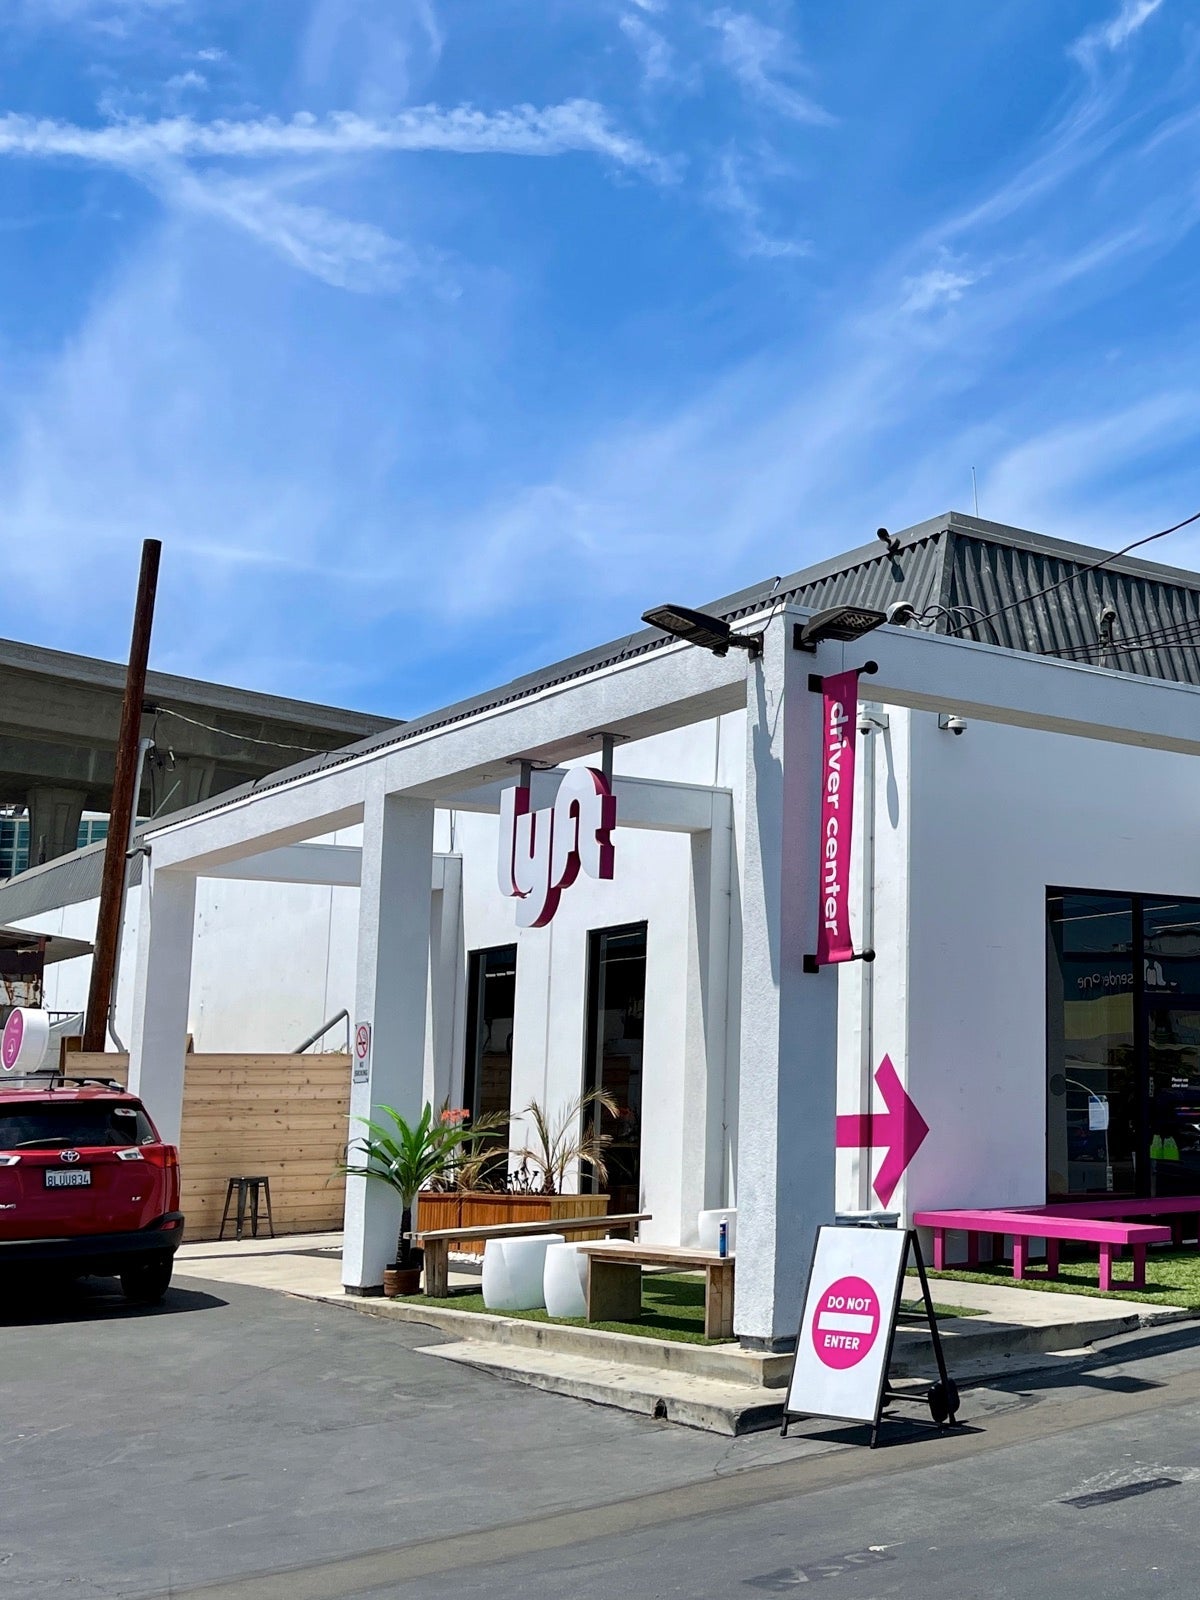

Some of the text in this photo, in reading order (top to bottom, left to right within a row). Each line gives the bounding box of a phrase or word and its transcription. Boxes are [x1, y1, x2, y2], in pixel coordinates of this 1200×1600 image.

[498, 766, 616, 928] lyft
[824, 701, 849, 937] driver center
[824, 1334, 861, 1351] ENTER
[827, 1295, 872, 1312] DO NOT
